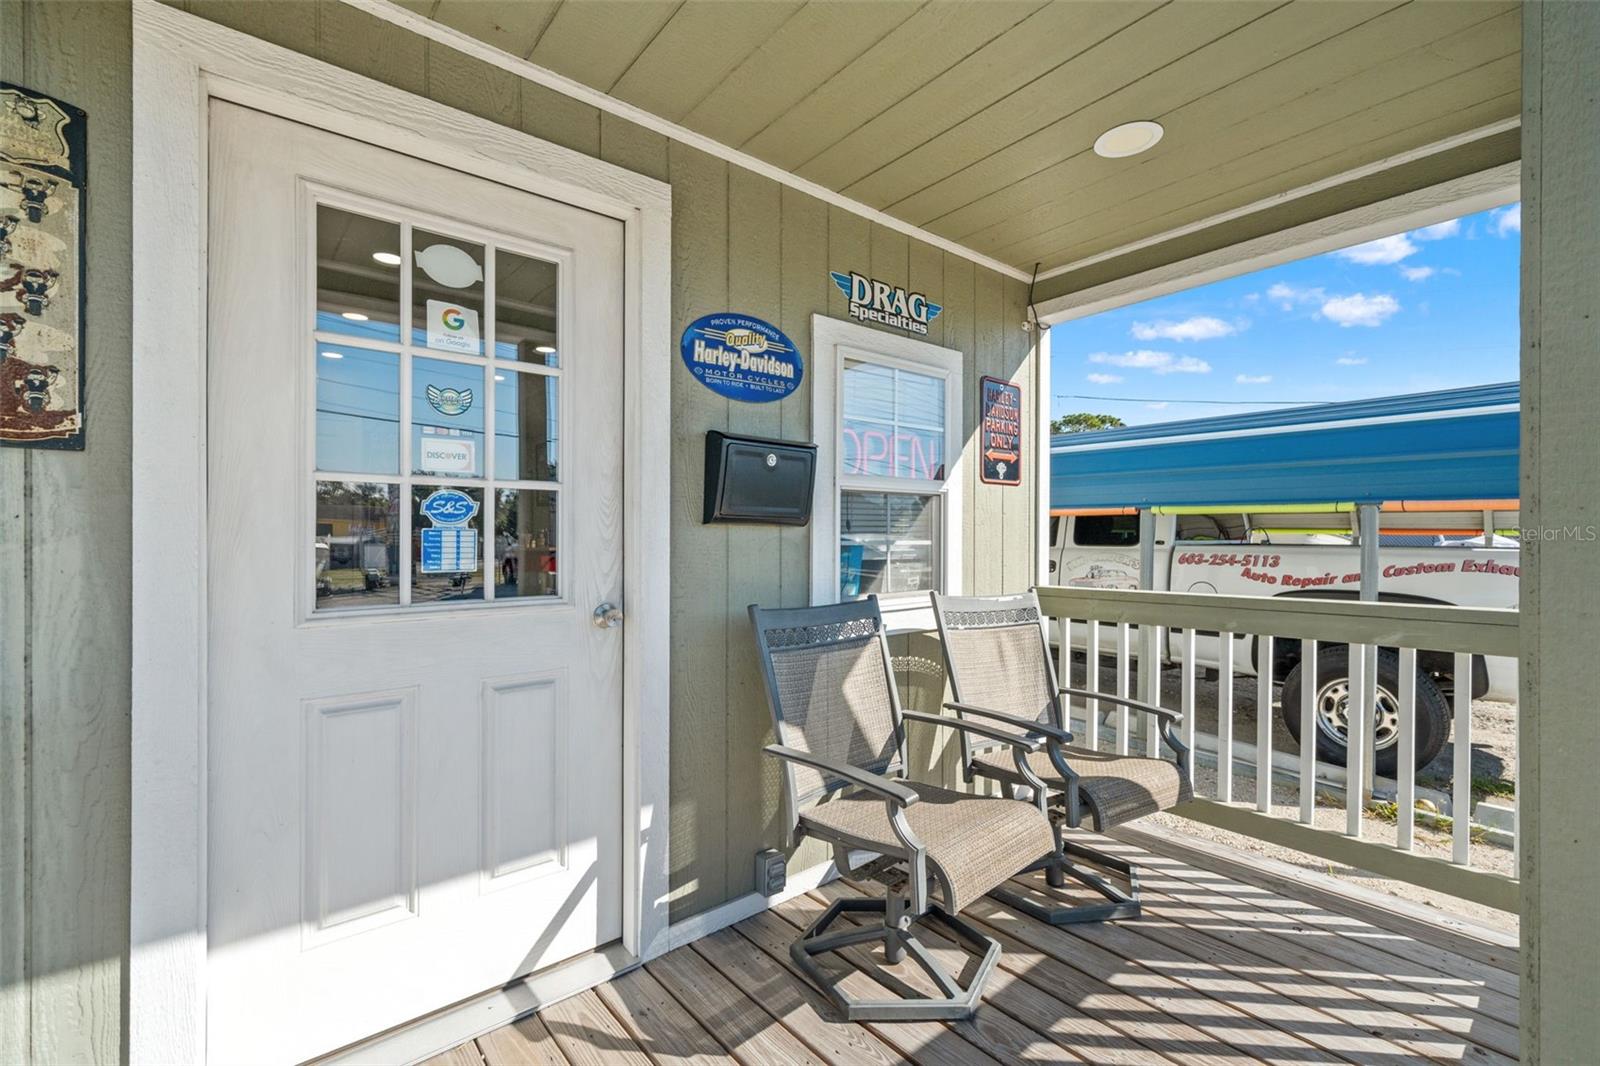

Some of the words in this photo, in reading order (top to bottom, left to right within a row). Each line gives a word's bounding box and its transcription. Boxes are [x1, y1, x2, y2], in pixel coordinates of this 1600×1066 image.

[849, 270, 928, 323] DRAG
[849, 302, 928, 335] Specialties
[737, 319, 780, 341] PERFORMANCE
[725, 332, 767, 349] Quality
[693, 339, 795, 379] Harley-Davidson
[705, 369, 743, 379] MOTOR
[747, 375, 786, 388] CYCLES
[705, 377, 722, 385] BORN
[985, 417, 1019, 436] PARKING
[990, 432, 1014, 449] ONLY
[426, 450, 467, 461] DISCOVER
[430, 500, 468, 514] S&S
[1241, 567, 1277, 584] Auto
[1281, 572, 1338, 588] Repair
[1383, 562, 1456, 578] Custom
